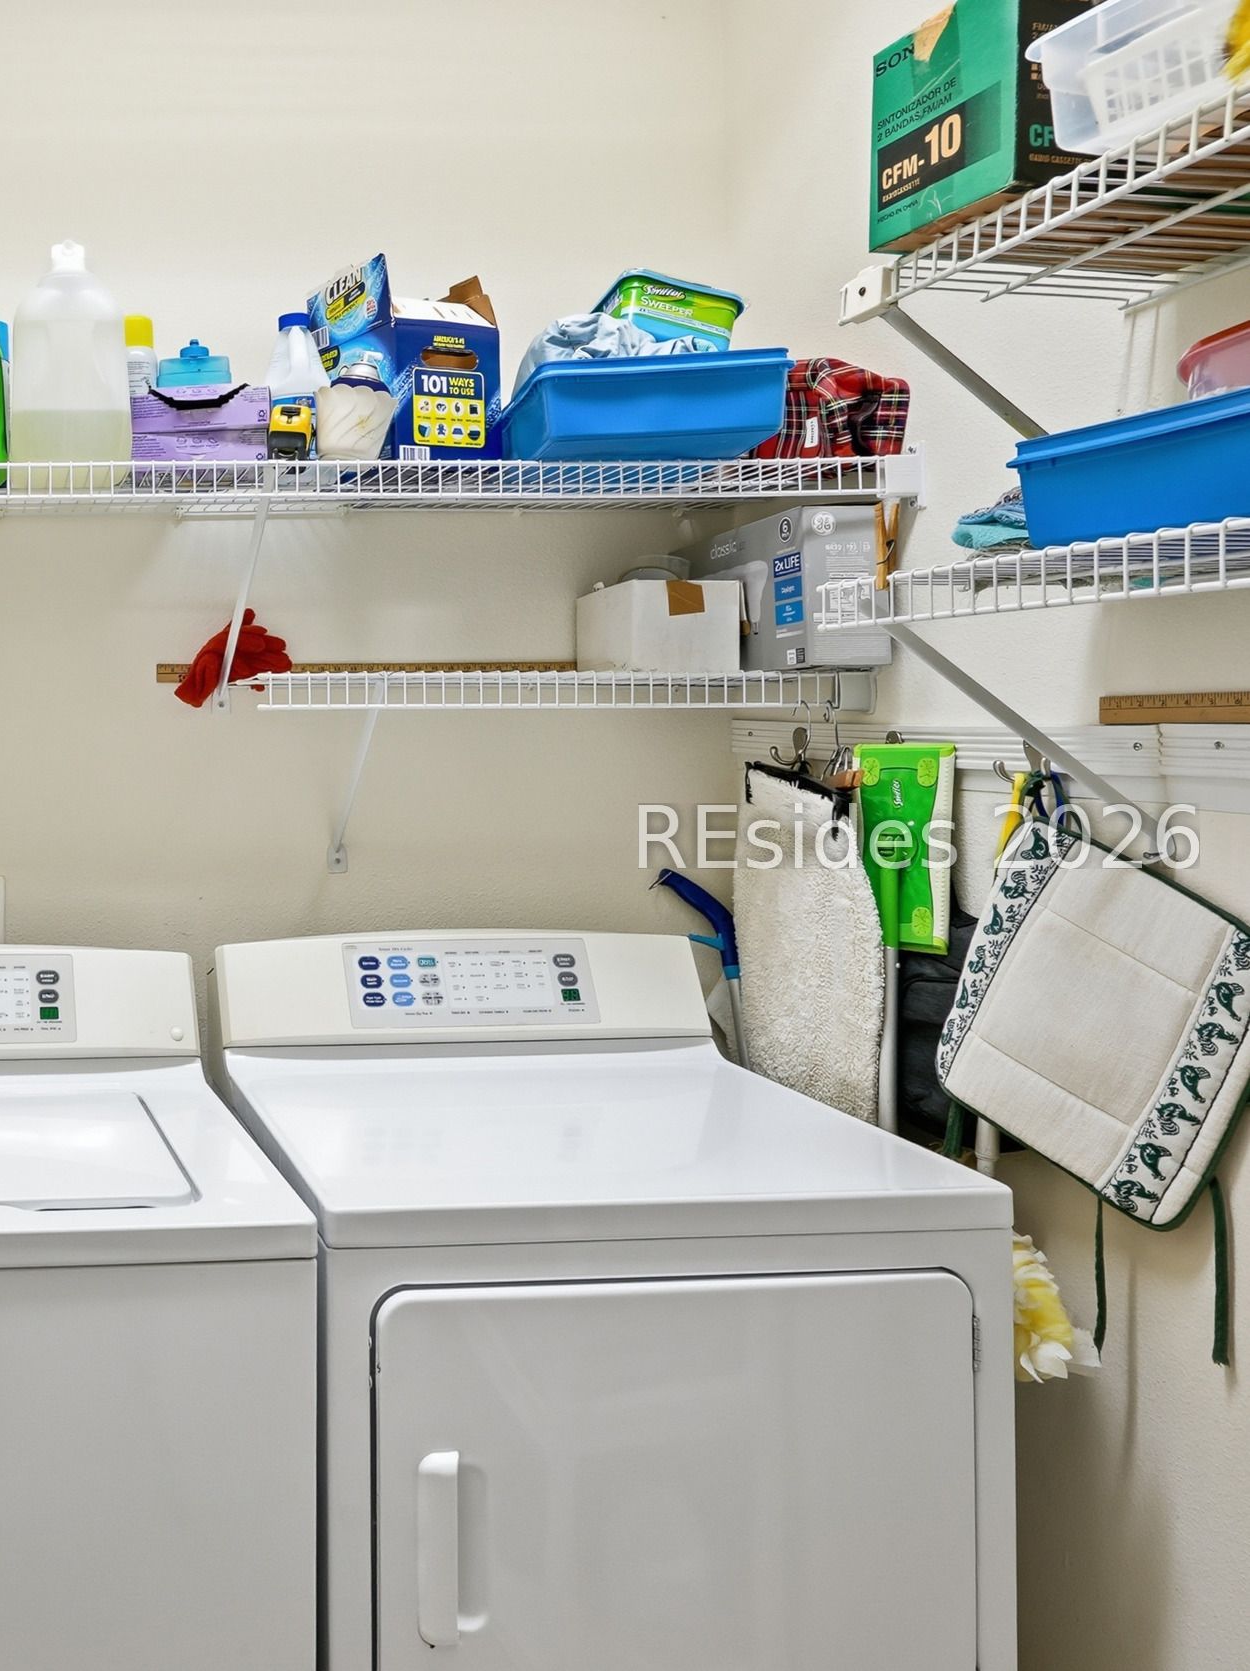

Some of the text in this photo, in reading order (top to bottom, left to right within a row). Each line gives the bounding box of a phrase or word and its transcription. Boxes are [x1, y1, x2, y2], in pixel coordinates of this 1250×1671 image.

[875, 43, 915, 78] SON
[877, 77, 957, 130] SINTONIZADOR DE
[1029, 124, 1054, 147] CF
[641, 296, 693, 317] SWEEPER
[421, 374, 475, 394] 101 WAYS
[449, 387, 475, 396] TO USE
[782, 521, 788, 532] 6
[784, 554, 800, 569] LIFE
